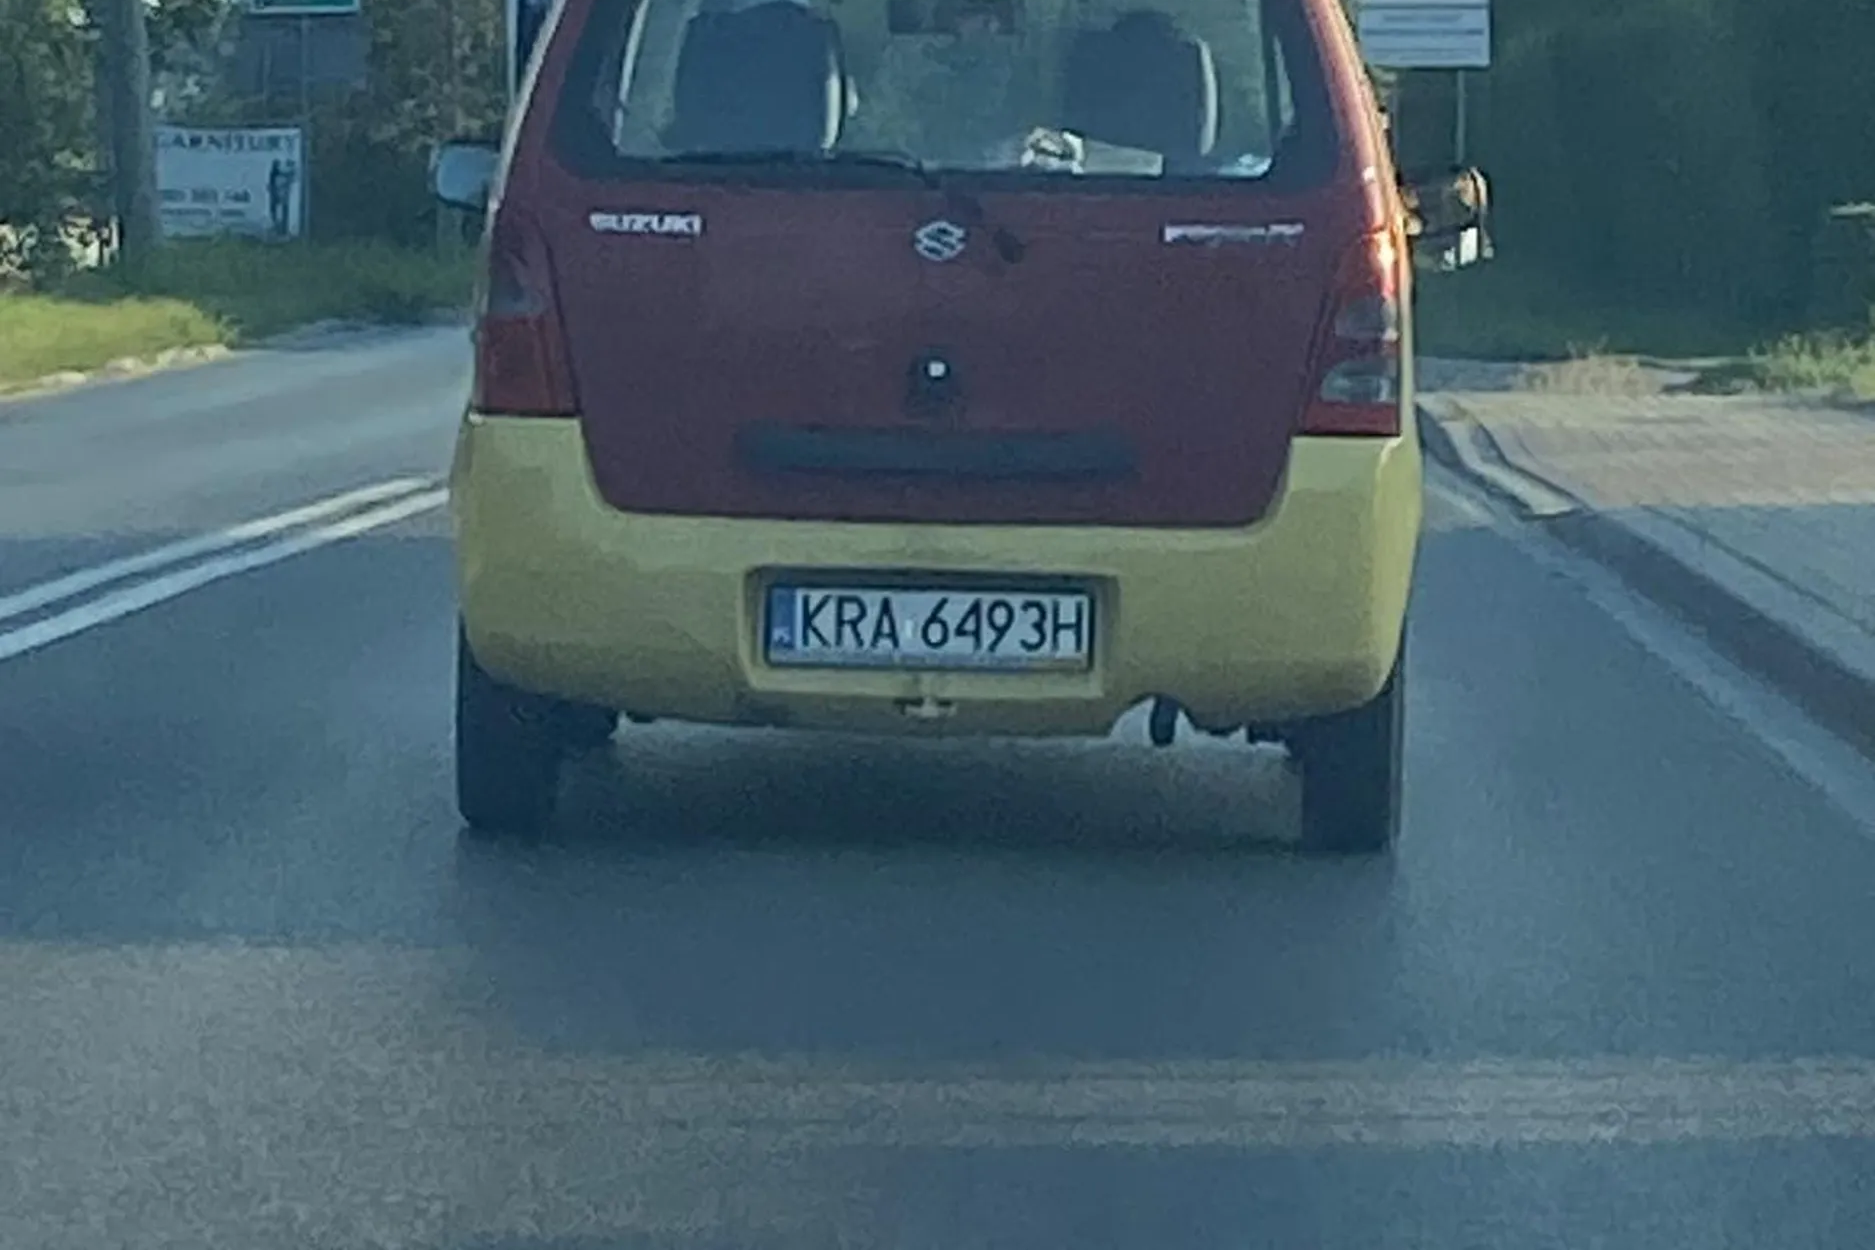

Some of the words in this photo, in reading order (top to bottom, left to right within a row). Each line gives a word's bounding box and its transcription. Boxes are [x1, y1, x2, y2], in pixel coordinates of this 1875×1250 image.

[589, 213, 701, 234] SUZUKI
[802, 594, 899, 649] KRA
[921, 597, 1083, 653] 6493H
